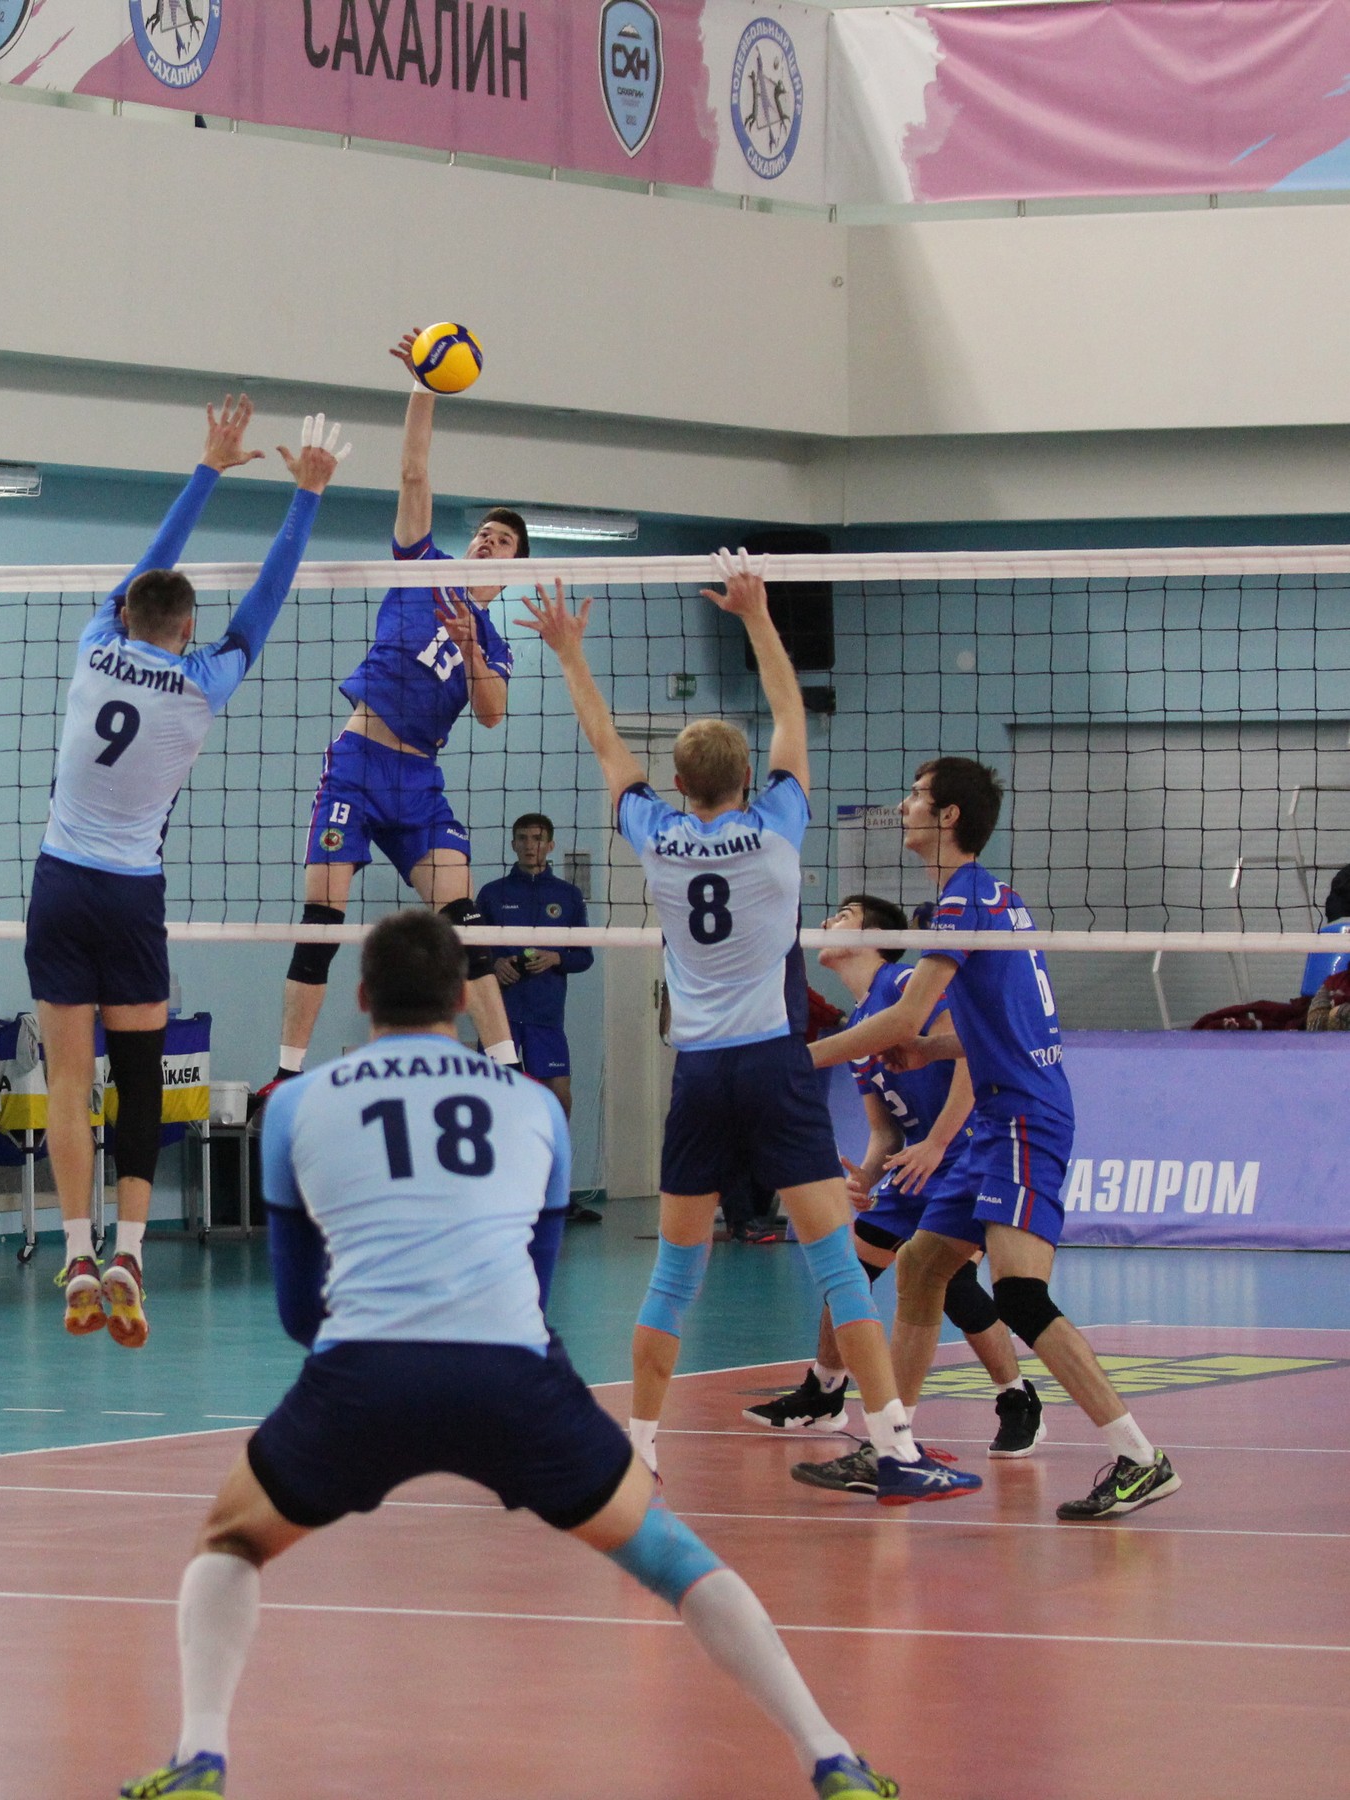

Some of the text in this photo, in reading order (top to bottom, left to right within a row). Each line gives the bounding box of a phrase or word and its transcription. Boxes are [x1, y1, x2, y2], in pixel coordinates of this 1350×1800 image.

[147, 50, 202, 85] САХАЛИН
[304, 0, 527, 100] САХАЛИН
[747, 146, 787, 177] САХАЛИН
[89, 649, 185, 695] САХАЛИН
[95, 700, 141, 767] 9
[330, 802, 351, 824] 13
[687, 873, 732, 945] 8
[162, 1060, 201, 1085] IKASA
[330, 1055, 515, 1087] САХАЛИН
[361, 1094, 494, 1180] 18
[1065, 1159, 1260, 1214] АЗПРОМ
